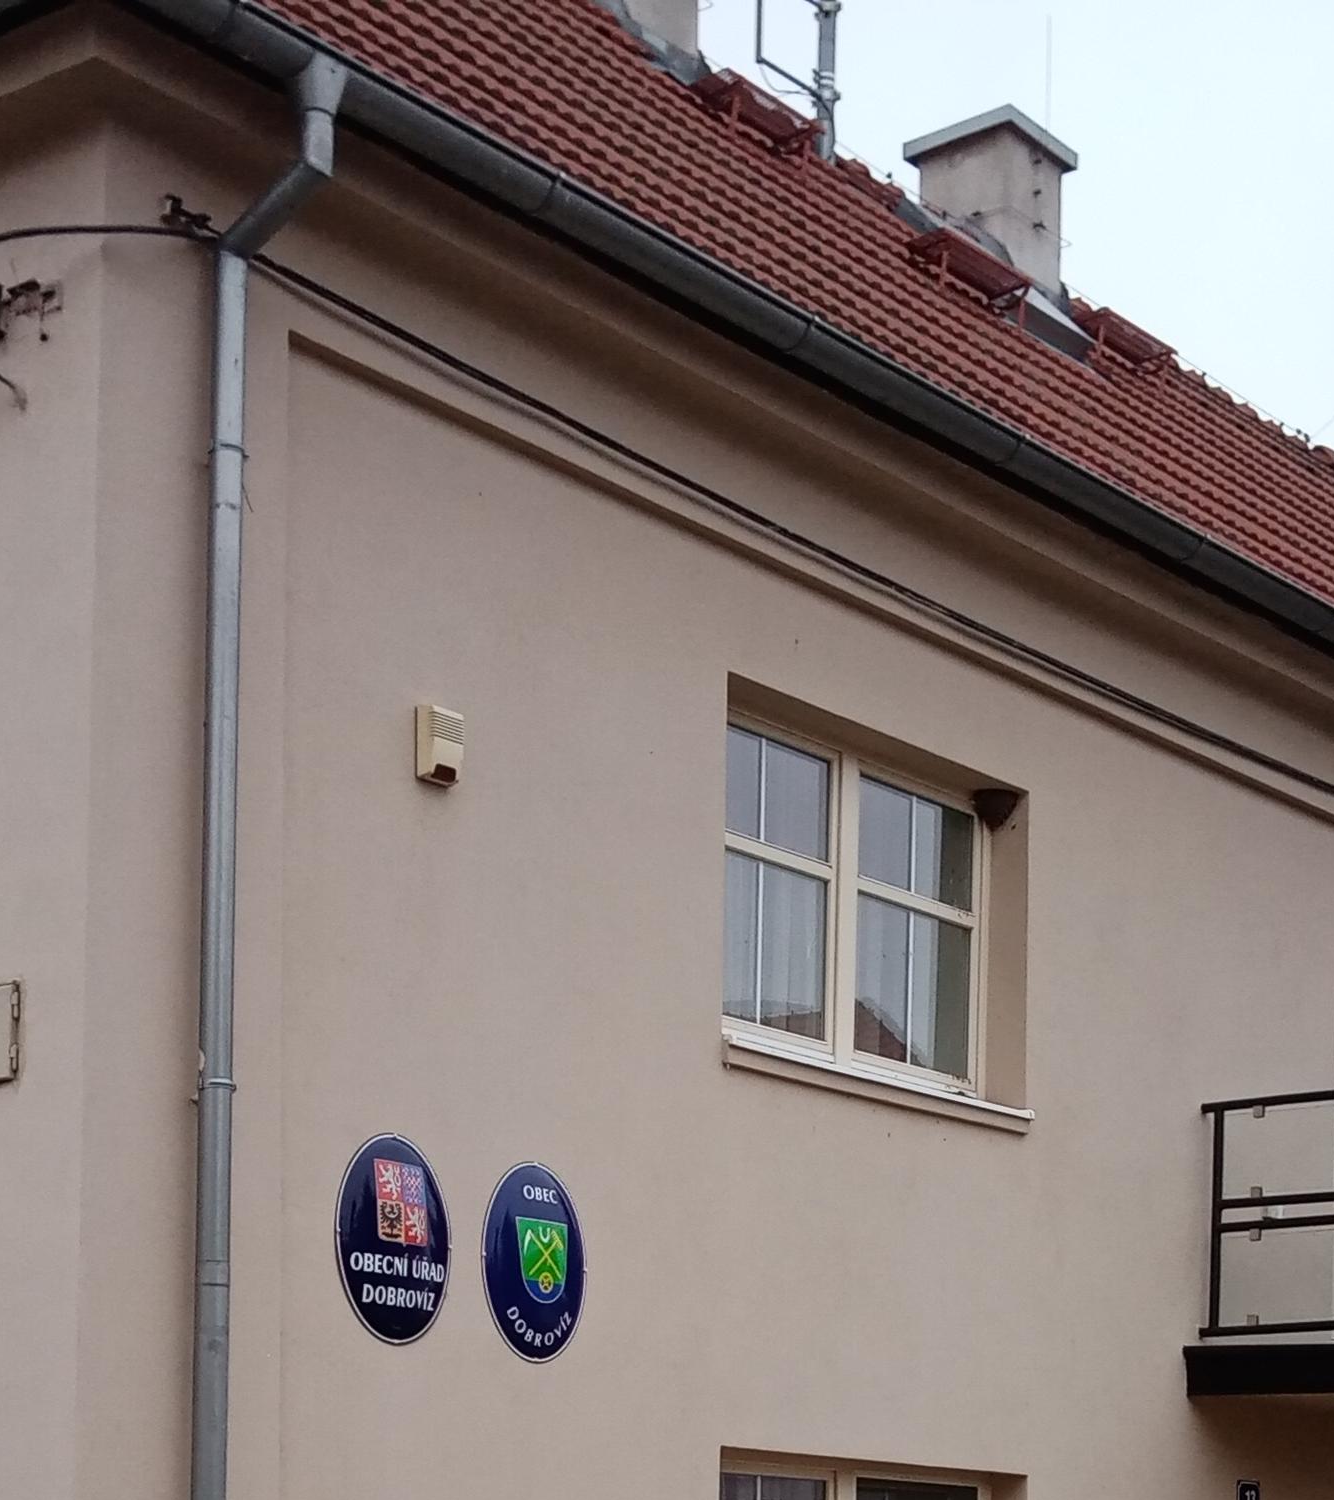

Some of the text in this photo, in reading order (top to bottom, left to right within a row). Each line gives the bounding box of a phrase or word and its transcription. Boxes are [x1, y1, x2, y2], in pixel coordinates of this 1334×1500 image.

[523, 1185, 558, 1204] OBEC
[350, 1252, 445, 1282] OBECNÍ ÚŘAD
[362, 1284, 435, 1311] DOBROVÍZ
[506, 1306, 572, 1347] DOBROVÍZ
